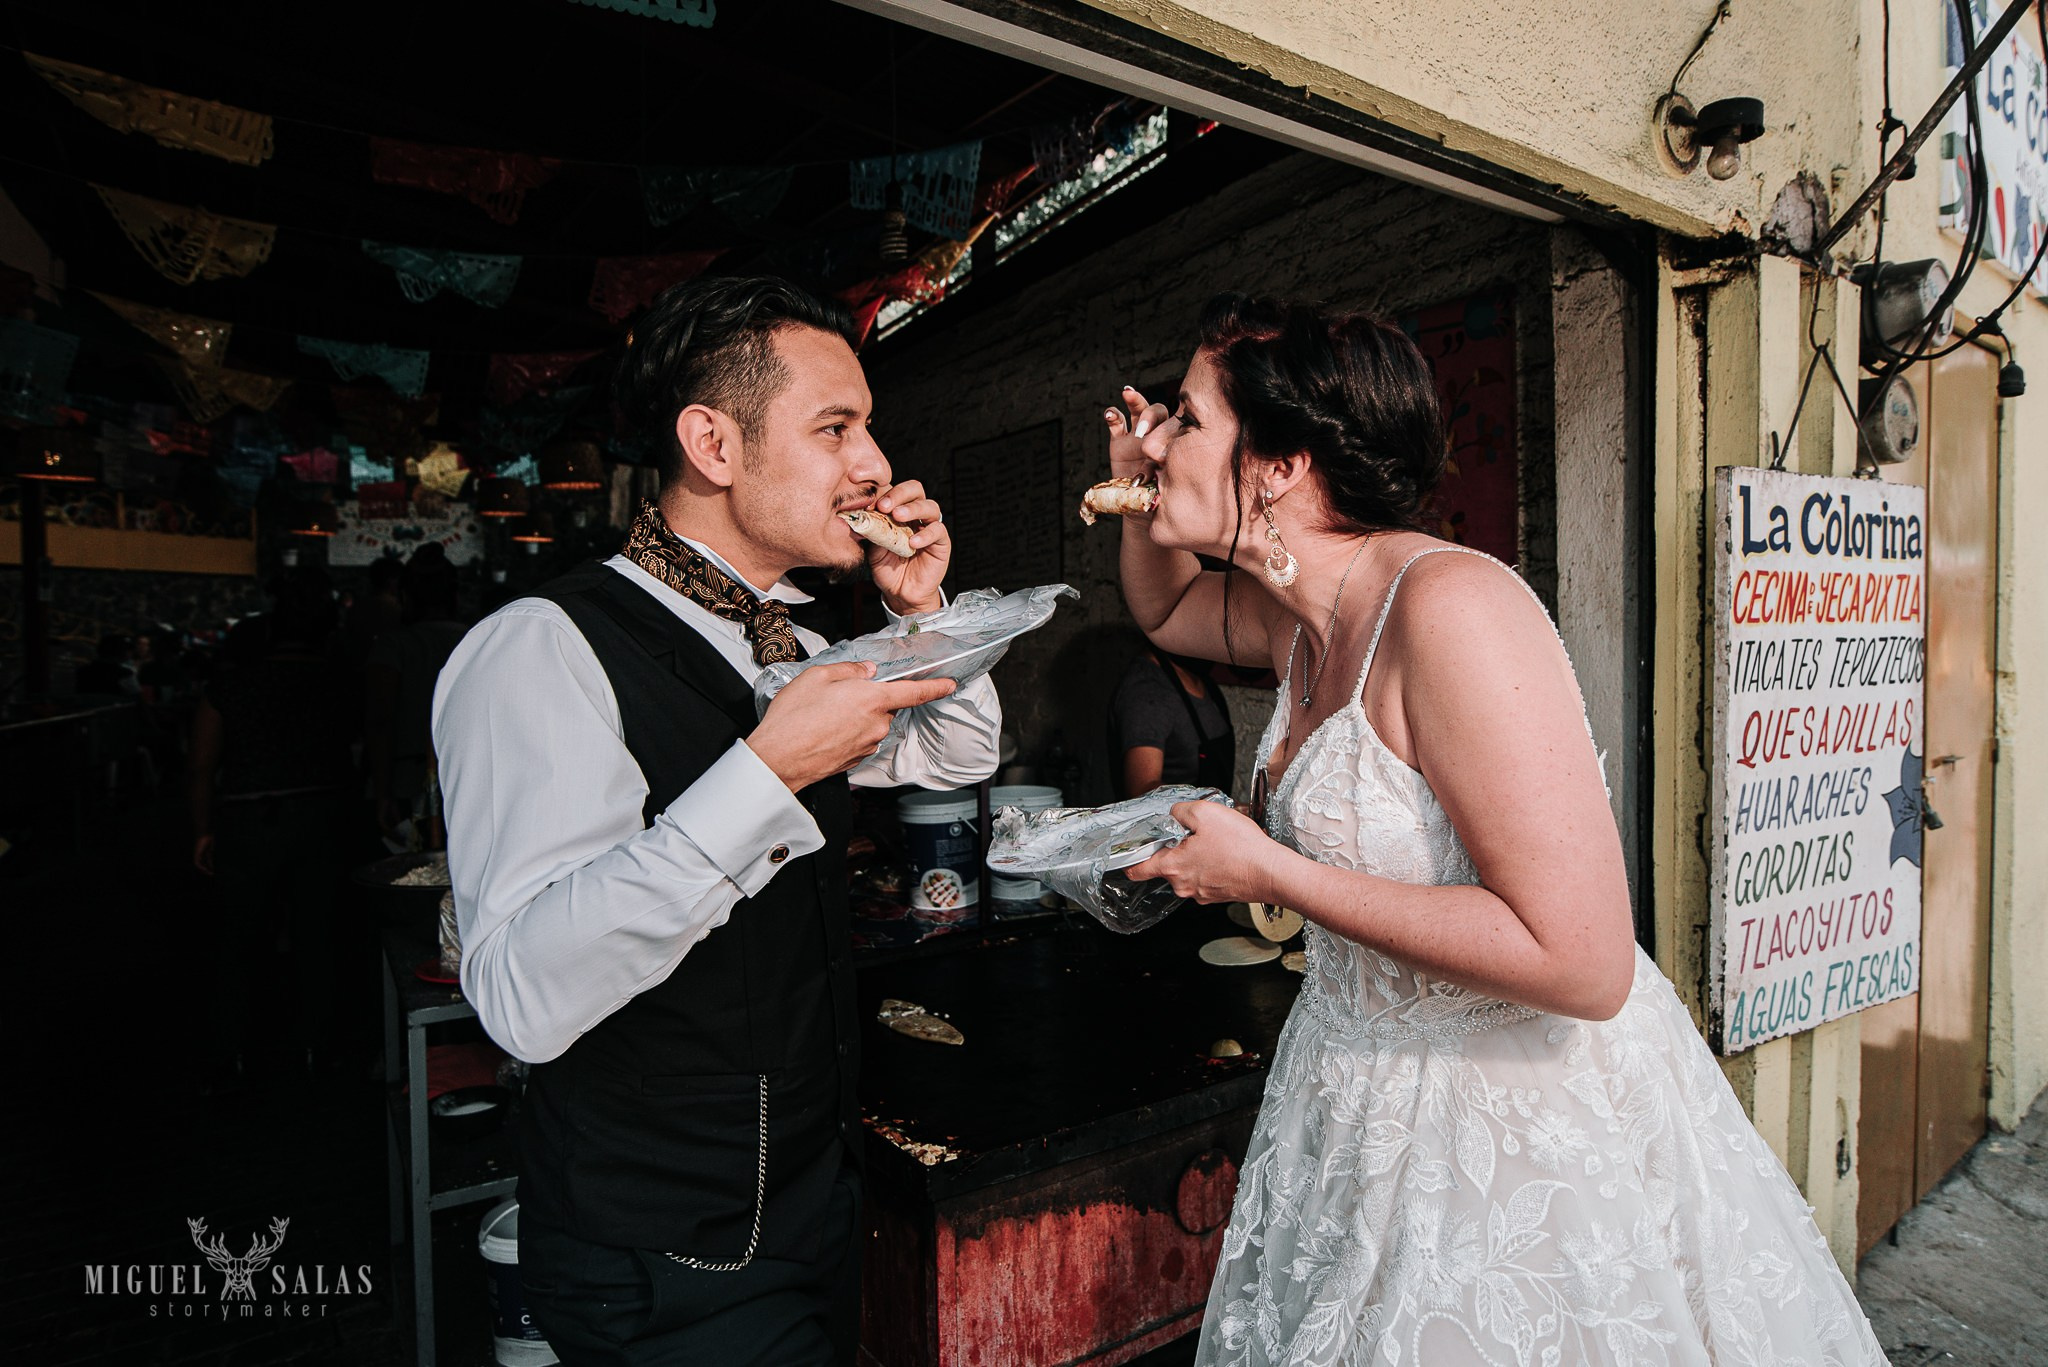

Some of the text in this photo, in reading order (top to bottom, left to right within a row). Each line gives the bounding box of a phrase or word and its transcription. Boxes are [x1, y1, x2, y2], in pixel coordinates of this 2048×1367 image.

[1986, 57, 2016, 129] La
[1738, 485, 1923, 560] La Colorina
[1733, 569, 1809, 624] CECINA
[1815, 571, 1921, 624] YECAPIXTLA
[1733, 636, 1924, 694] ITACATES TEPOZTECOS
[1736, 698, 1914, 769] QUESADILLAS
[1735, 766, 1872, 836] HUARACHES
[1734, 830, 1854, 907] GORDITAS
[1738, 887, 1894, 974] TLACOYITOS
[1728, 942, 1913, 1045] AGUAS FRESCAS
